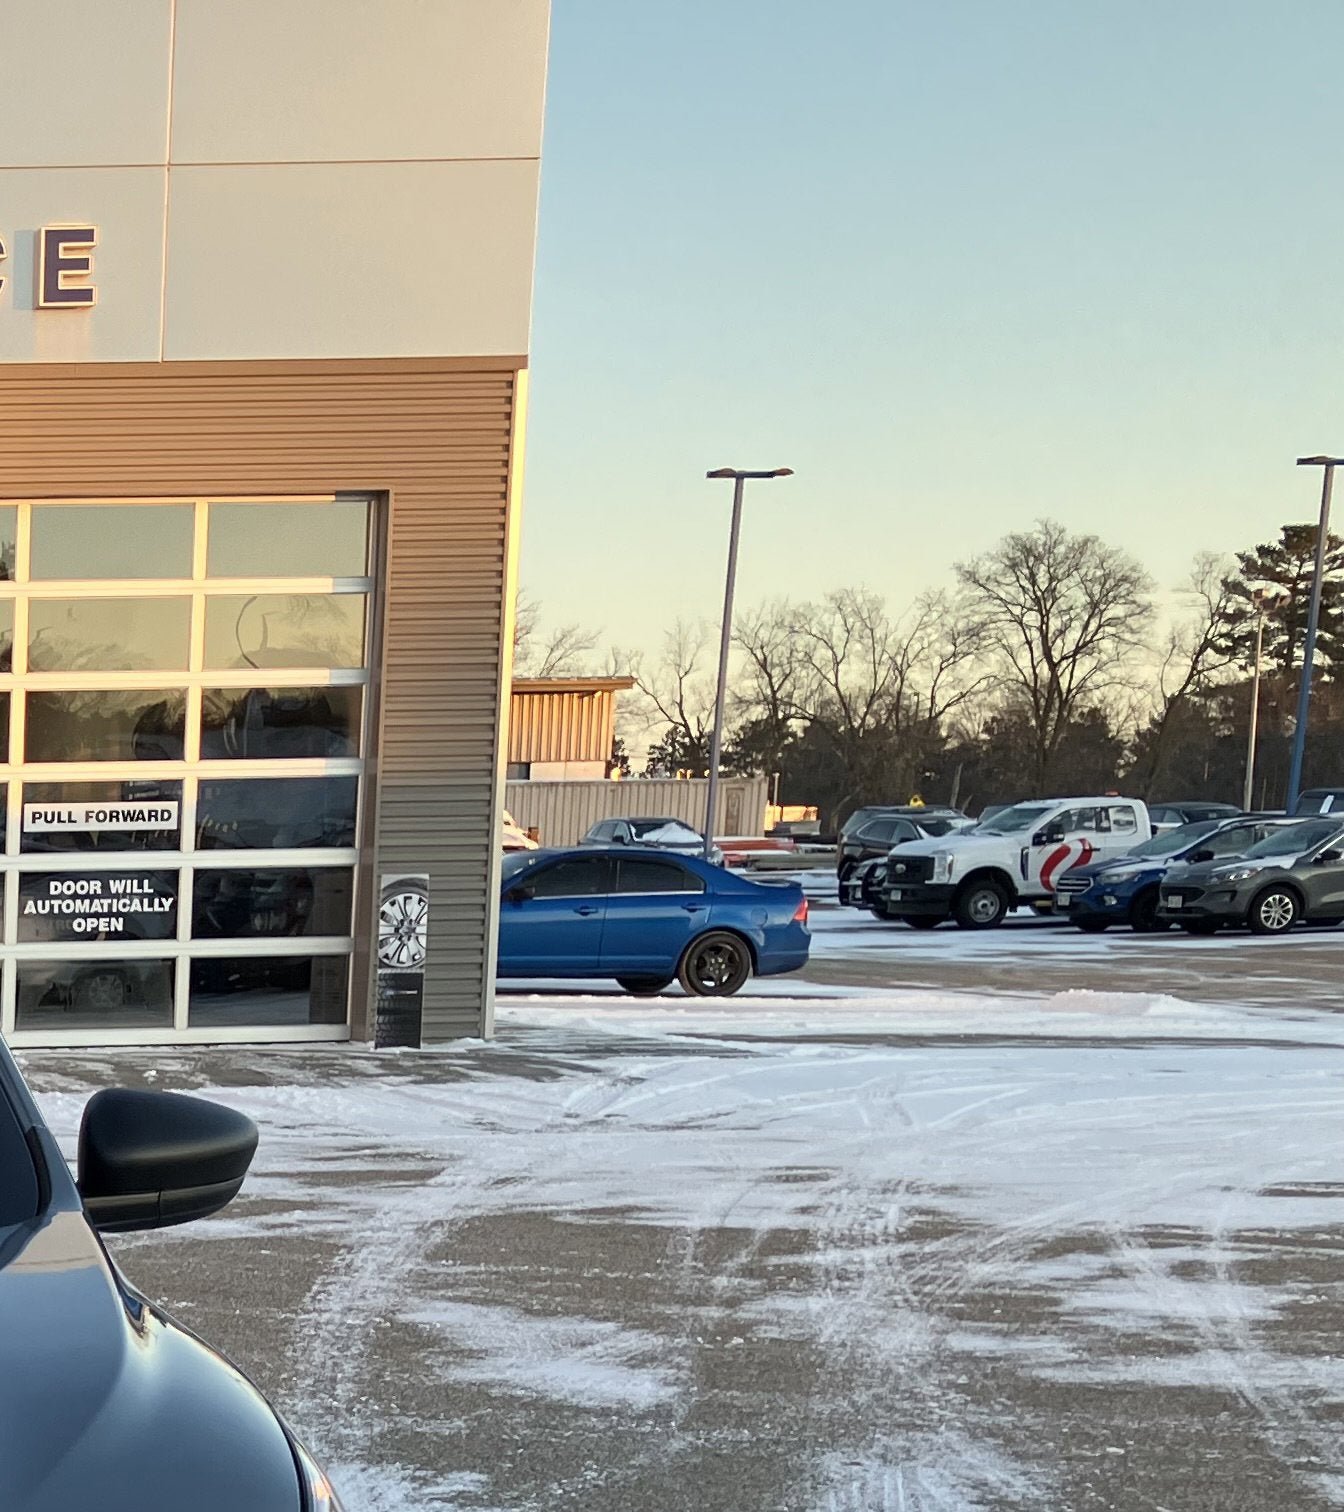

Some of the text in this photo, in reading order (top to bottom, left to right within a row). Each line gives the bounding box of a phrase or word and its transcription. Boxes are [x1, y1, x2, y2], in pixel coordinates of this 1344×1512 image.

[31, 808, 172, 825] PULL FORWARD
[49, 879, 154, 896] DOOR WILL
[23, 896, 174, 915] AUTOMATICALLY
[72, 917, 124, 933] OPEN
